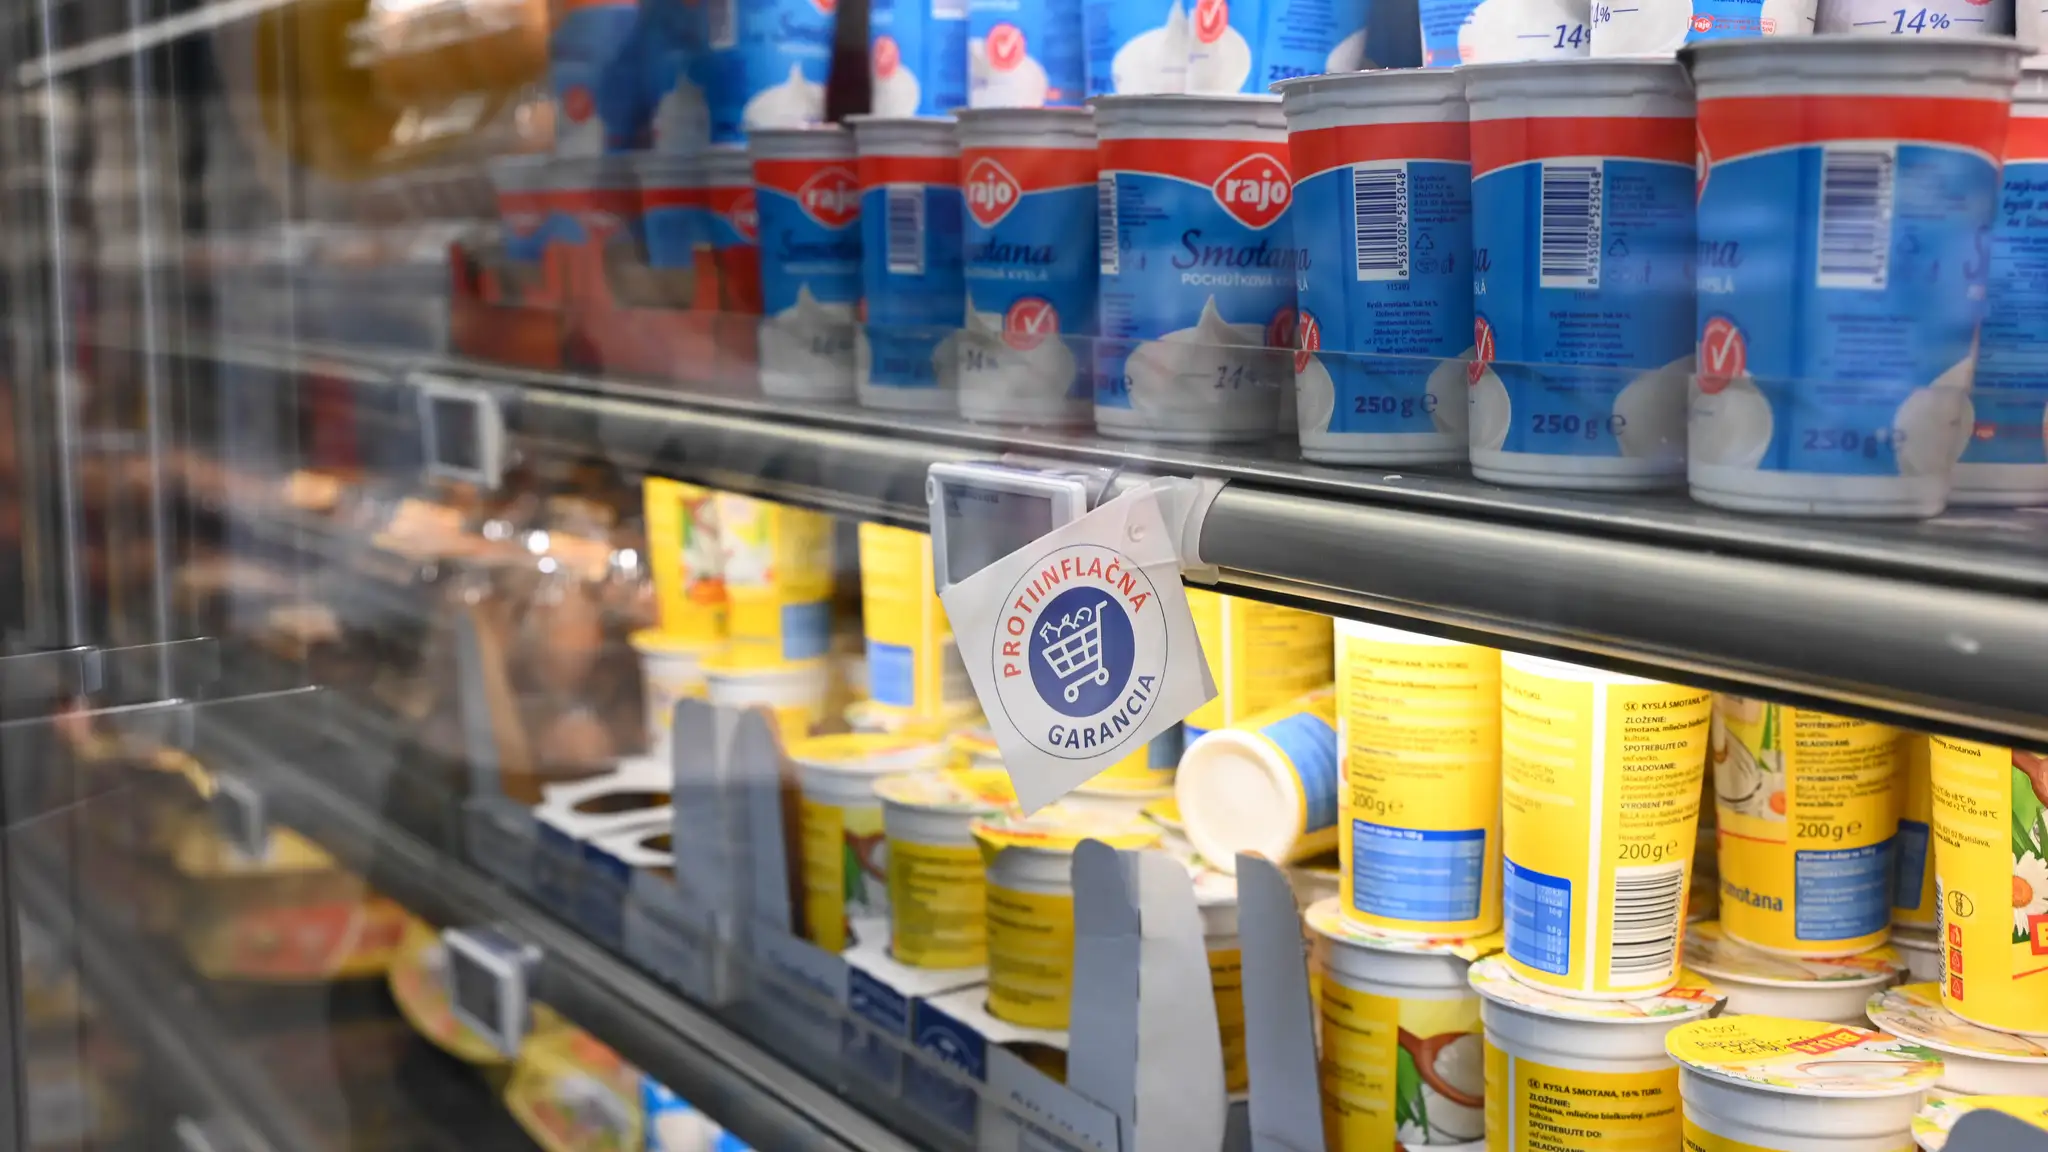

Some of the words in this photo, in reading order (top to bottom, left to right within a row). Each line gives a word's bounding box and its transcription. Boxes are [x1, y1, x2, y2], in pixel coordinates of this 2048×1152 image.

[1891, 9, 1950, 34] 14%
[970, 171, 1013, 212] rajo
[1226, 169, 1288, 211] rajo
[1355, 395, 1397, 414] 250
[1401, 398, 1413, 418] g
[1532, 414, 1580, 434] 250
[1585, 417, 1598, 440] g
[1803, 428, 1860, 451] 250
[1003, 556, 1152, 679] PROTIINFLAČNÁ
[1048, 675, 1156, 750] GARANCIA
[1641, 700, 1668, 710] KYSLÁ
[1625, 716, 1667, 724] ZLOŽENIE:
[1623, 743, 1676, 752] SPOTREBUJTE
[1967, 797, 1977, 806] Po
[1968, 807, 1978, 815] do
[1796, 822, 1830, 839] 200
[1832, 827, 1844, 842] g
[1958, 832, 1991, 848] Bratislava,
[1543, 1082, 1570, 1094] KYSLÁ
[1571, 1087, 1620, 1098] SMOTANA,
[1529, 1092, 1571, 1108] ZLOŽENIE:
[1529, 1119, 1585, 1138] SPOTREBUJTE
